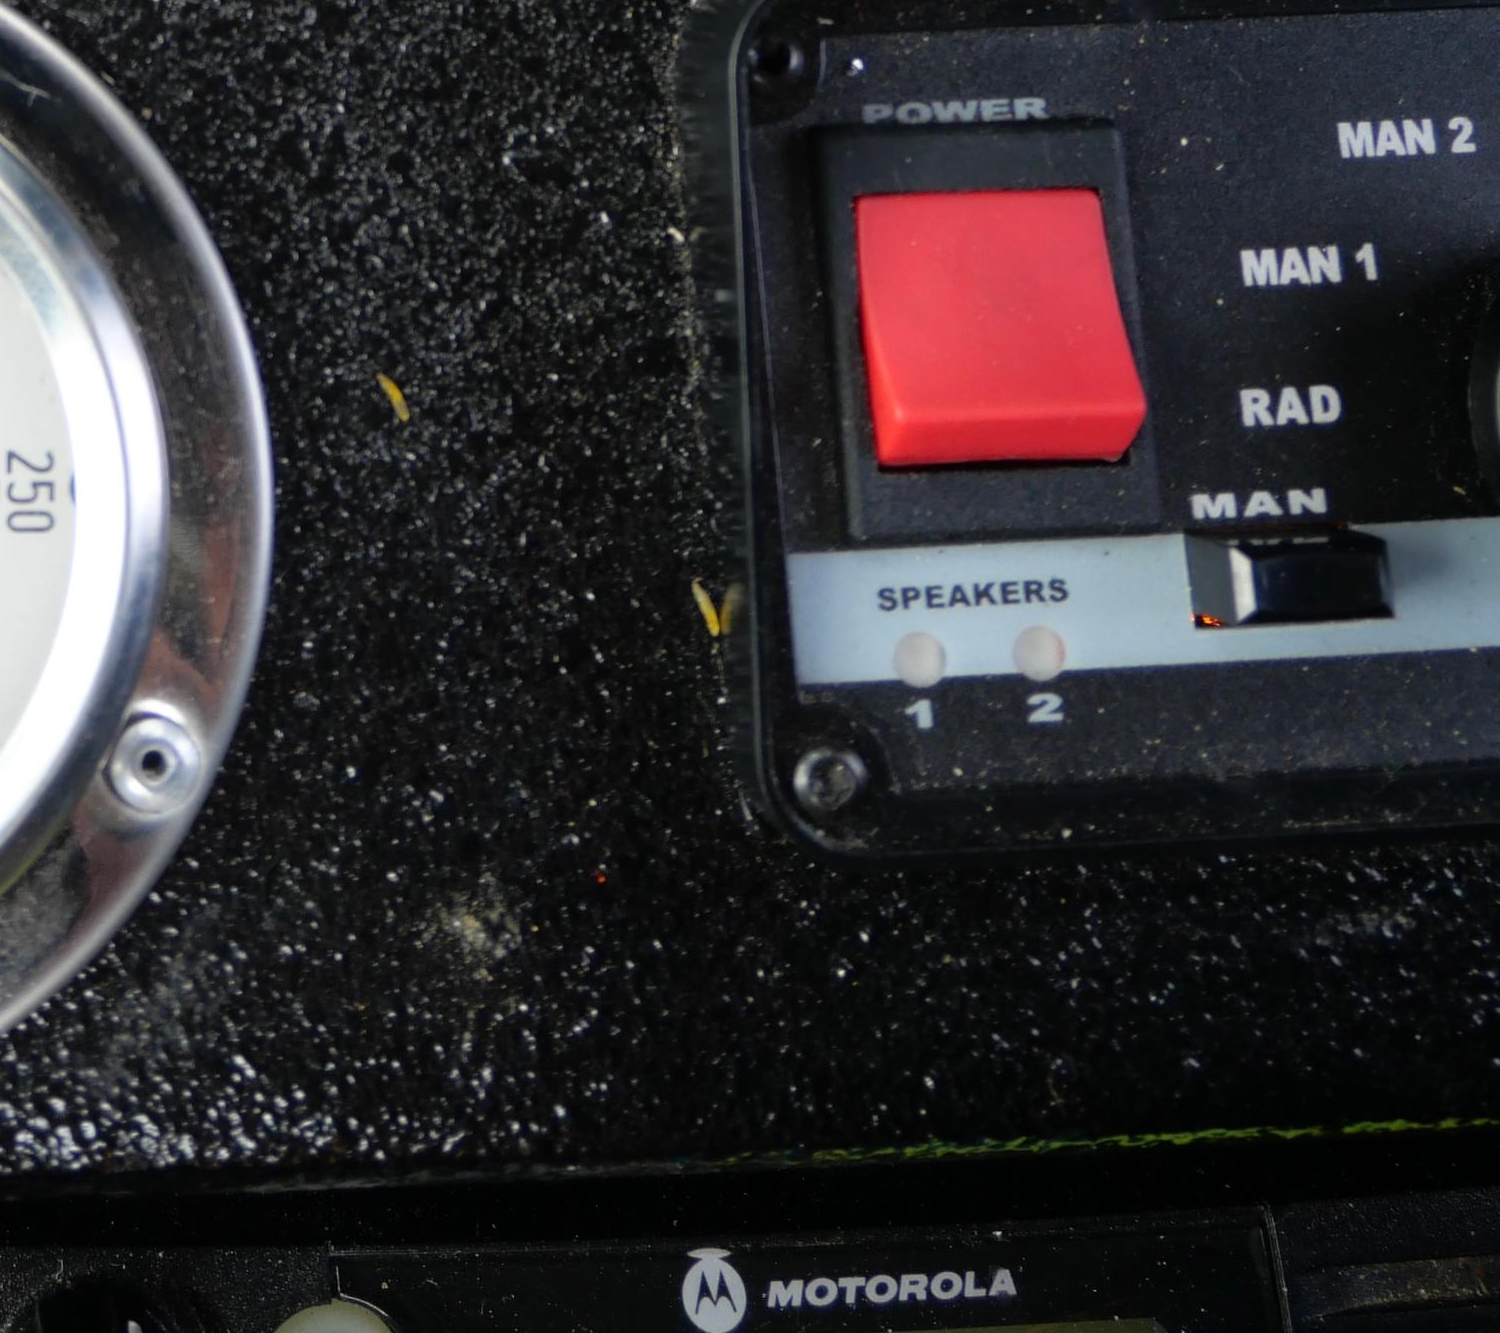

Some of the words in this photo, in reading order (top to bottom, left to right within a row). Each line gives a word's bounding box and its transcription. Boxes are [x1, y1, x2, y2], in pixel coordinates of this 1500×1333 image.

[861, 97, 1049, 124] POWER
[1336, 118, 1436, 158] MAN
[1448, 116, 1477, 153] 2
[1240, 245, 1342, 286] MAN
[1355, 242, 1378, 281] 1
[1240, 385, 1342, 427] RAD
[6, 450, 55, 534] 250
[1191, 487, 1328, 520] MAN
[877, 579, 1069, 612] SPEAKERS
[904, 698, 934, 729] 1
[1026, 692, 1065, 724] 2
[768, 1269, 1017, 1308] MOTOROLA
